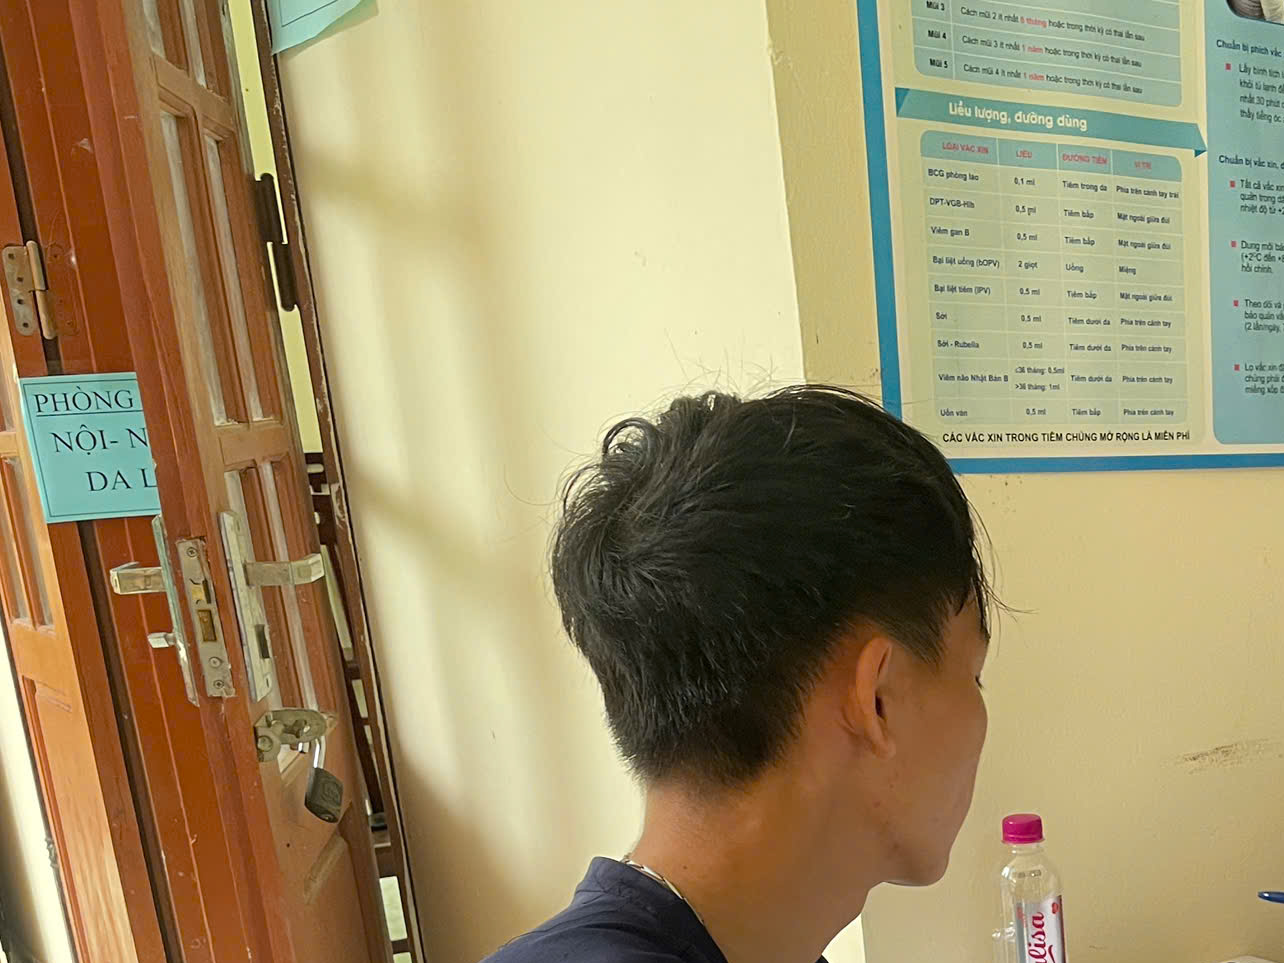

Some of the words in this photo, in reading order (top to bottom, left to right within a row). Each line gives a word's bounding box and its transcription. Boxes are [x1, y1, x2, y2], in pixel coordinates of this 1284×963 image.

[941, 3, 945, 11] 3
[942, 32, 947, 40] 4
[944, 60, 948, 69] 5
[948, 100, 972, 117] Liều
[974, 106, 1011, 124] lượng,
[1015, 111, 1054, 128] đường
[1057, 114, 1087, 131] dùng
[928, 168, 944, 177] BCG
[1018, 260, 1022, 268] 2
[33, 385, 134, 413] PHÒNG
[50, 424, 120, 456] NỘI-
[942, 431, 963, 442] CÁC
[987, 433, 1003, 442] XIN
[1005, 432, 1039, 442] TRONG
[1041, 431, 1063, 441] TIÊM
[1065, 430, 1097, 442] CHỦNG
[1100, 429, 1114, 441] MỞ
[1115, 431, 1140, 443] RỘNG
[1141, 429, 1152, 440] LÀ
[1154, 430, 1174, 440] MIỄN
[1176, 430, 1190, 440] PHÍ
[84, 470, 131, 492] DA
